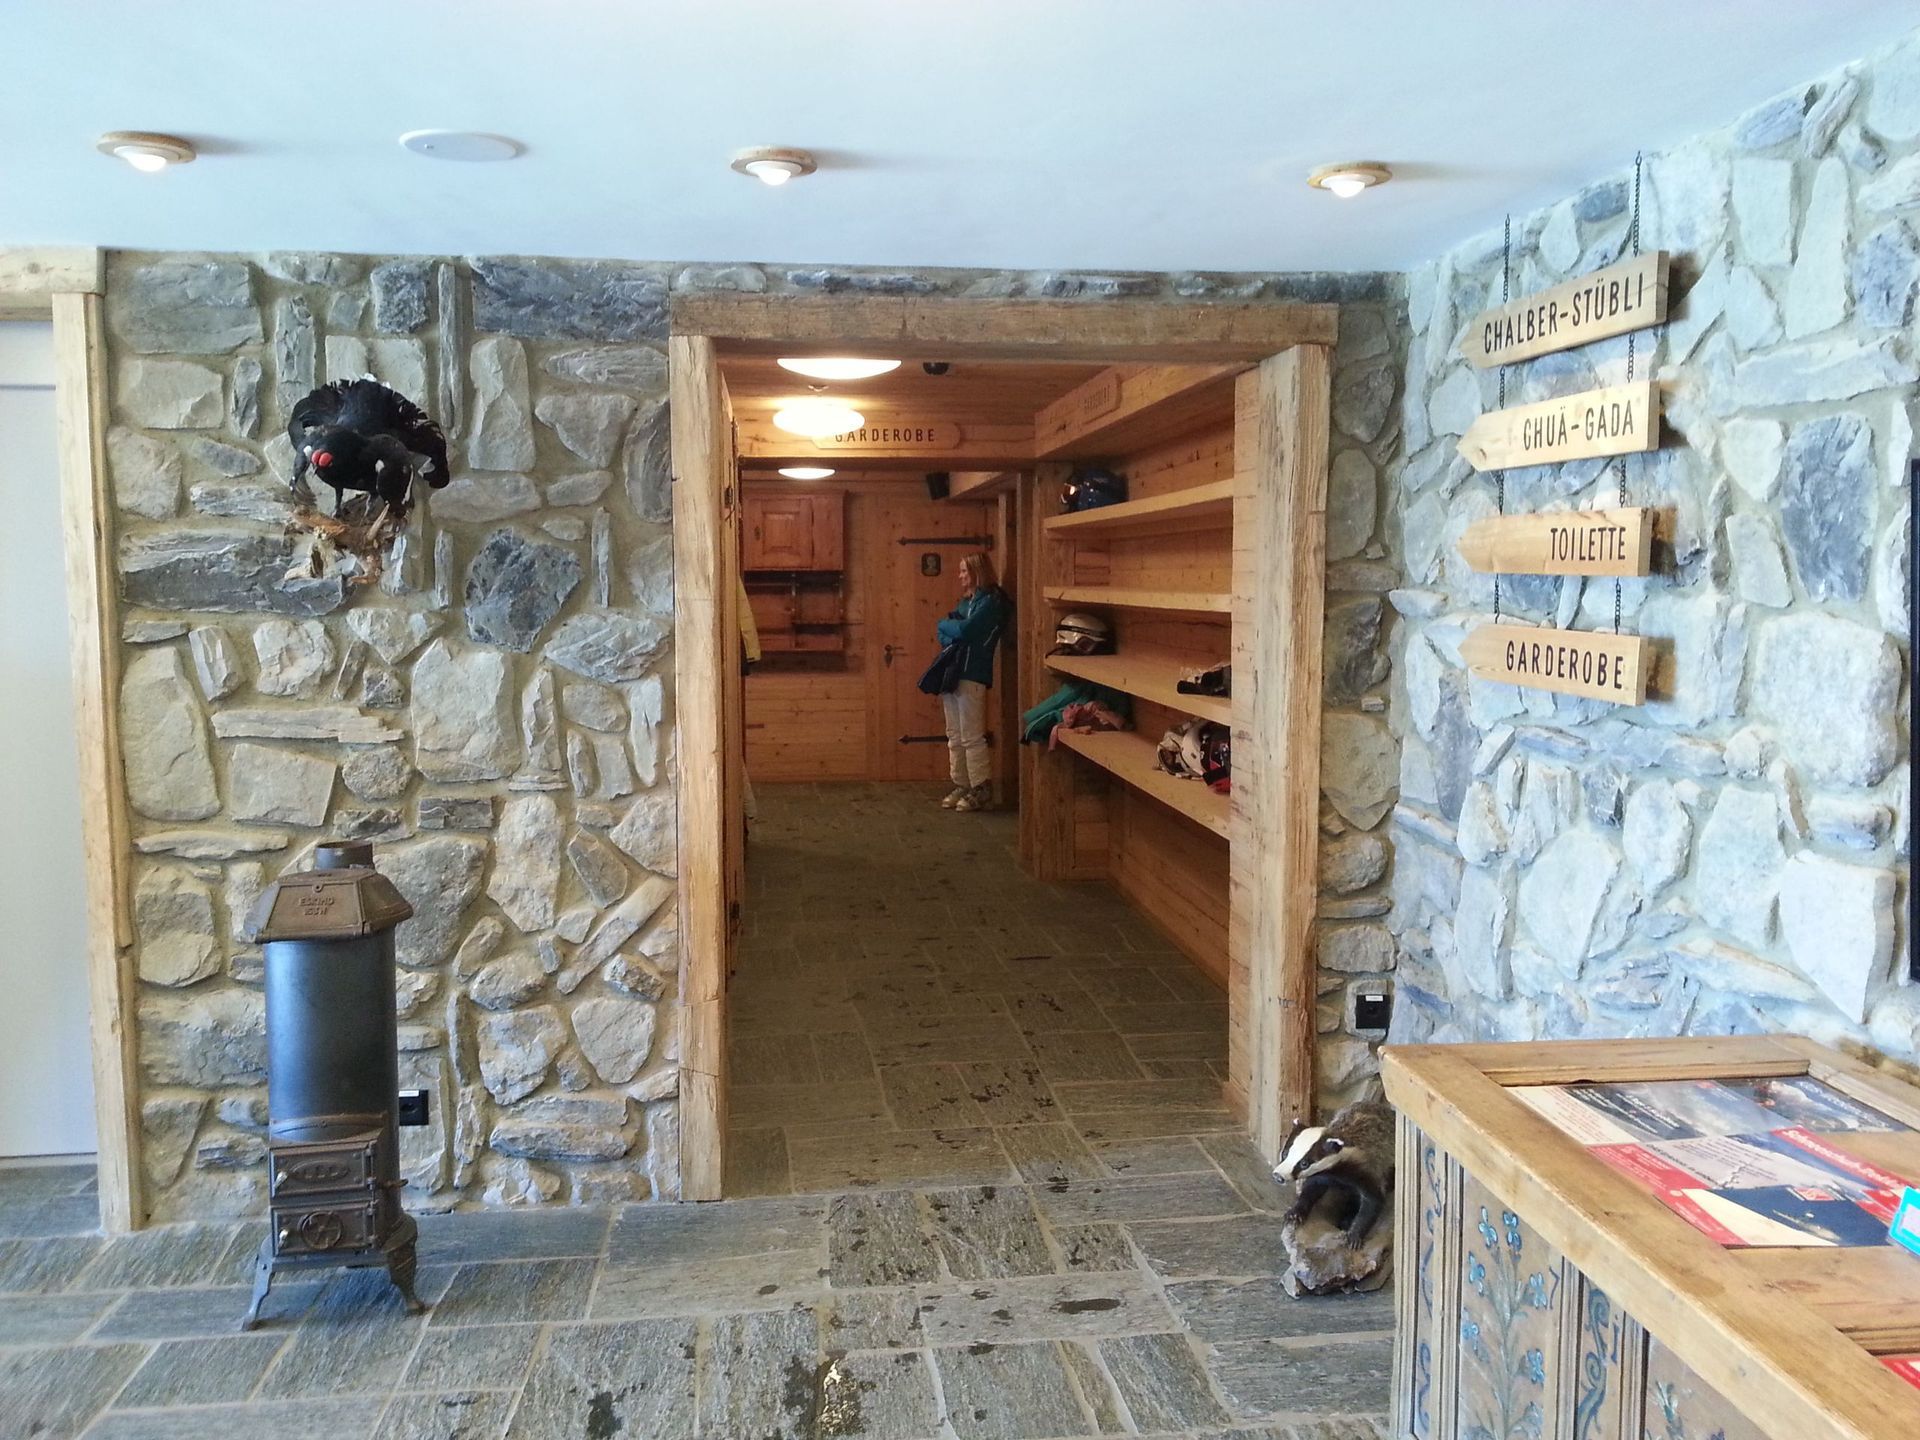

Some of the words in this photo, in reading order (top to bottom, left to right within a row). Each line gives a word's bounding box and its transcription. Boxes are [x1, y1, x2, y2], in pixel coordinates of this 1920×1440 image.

[1484, 272, 1643, 354] CHALBER-STÜBLI
[835, 428, 935, 442] GARDEROBE
[1523, 400, 1633, 451] CHUÄ-GADA
[1550, 527, 1626, 561] TOILETTE
[1506, 640, 1624, 690] GARDEROBE
